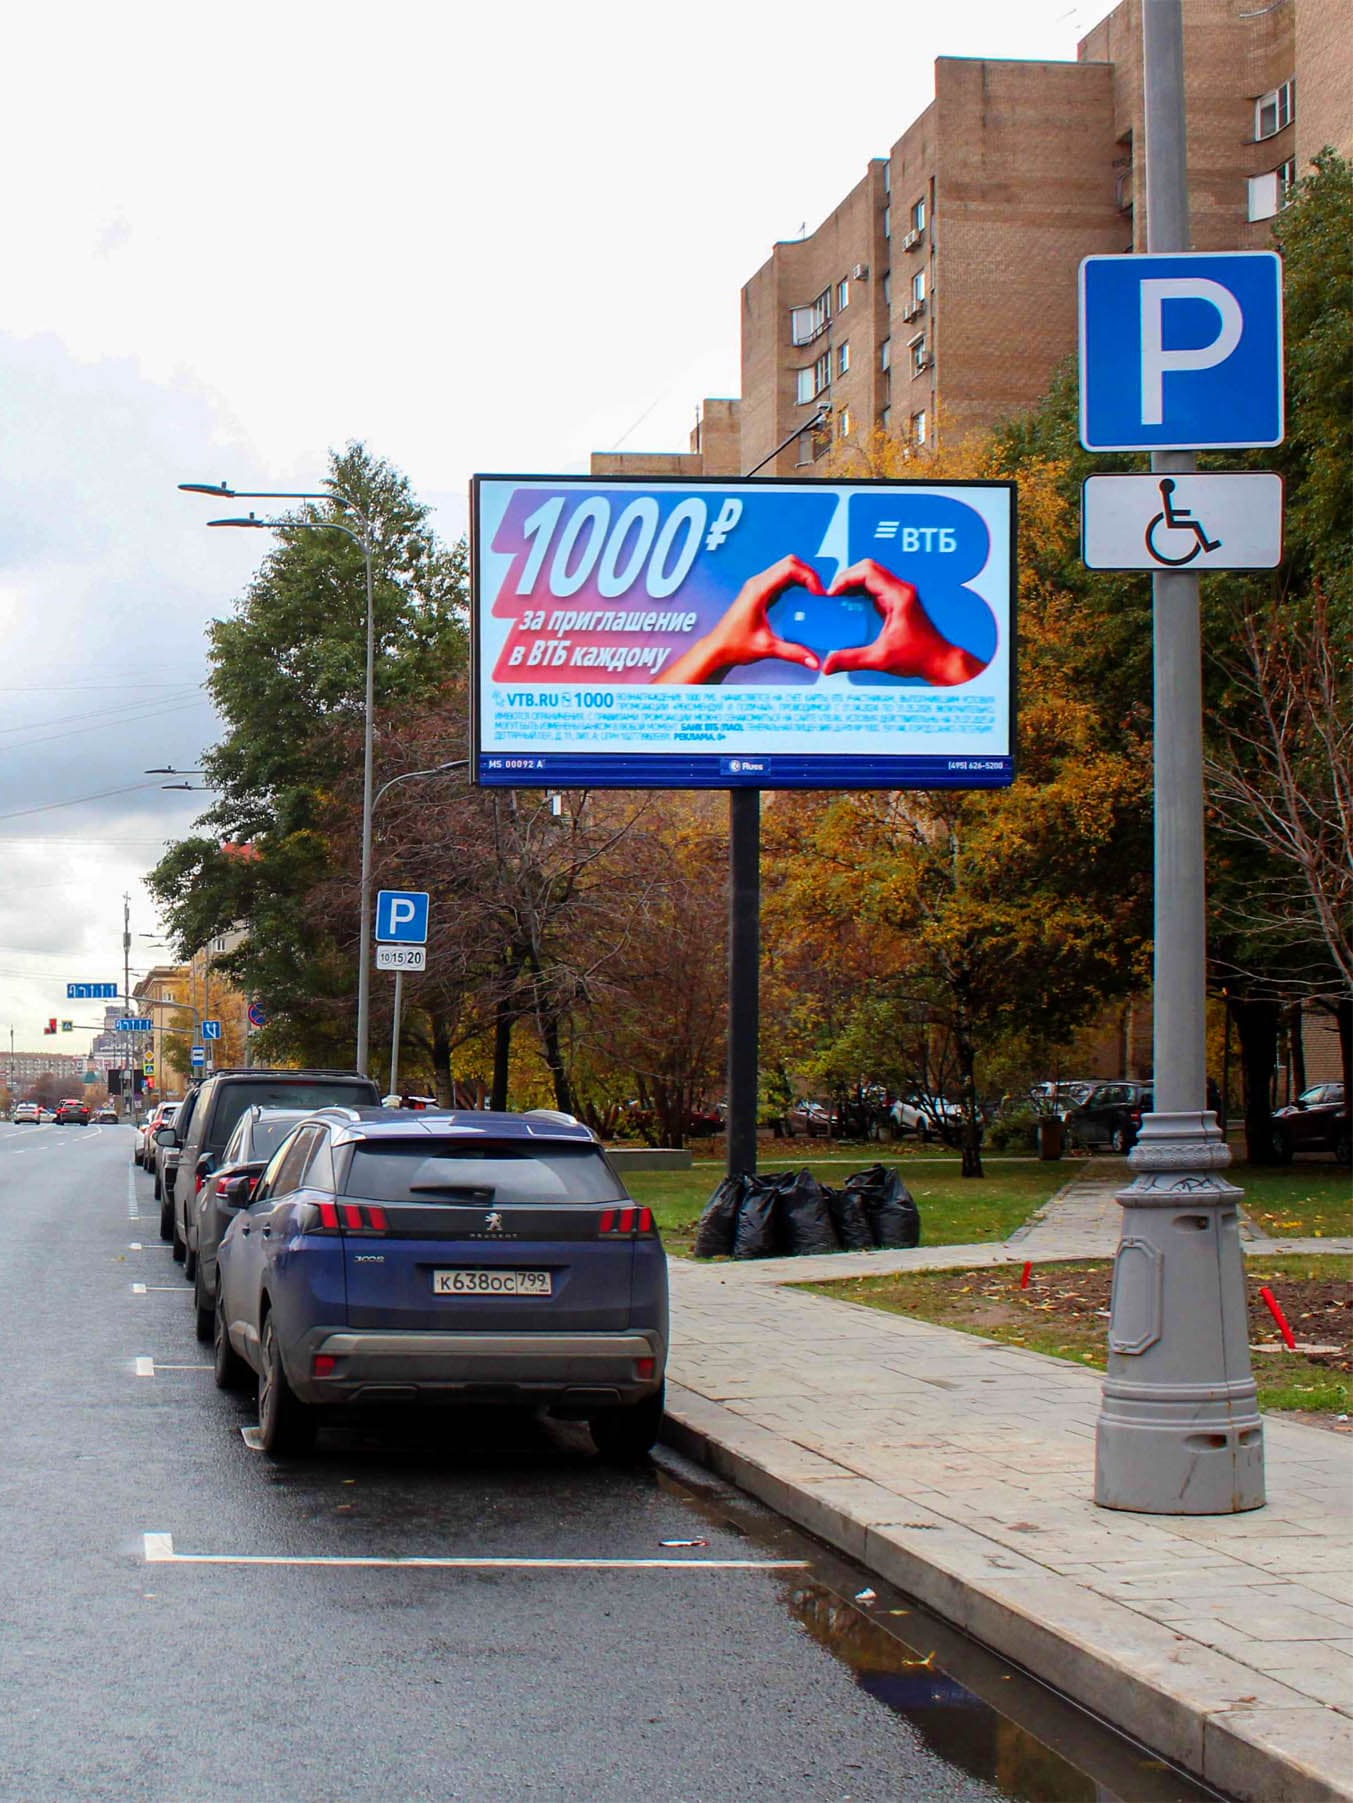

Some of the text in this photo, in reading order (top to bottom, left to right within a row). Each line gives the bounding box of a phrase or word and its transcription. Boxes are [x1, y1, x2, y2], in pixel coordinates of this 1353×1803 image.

[1140, 277, 1243, 425] P
[902, 527, 957, 553] ВТБ
[518, 610, 697, 638] за приглашение
[508, 640, 672, 674] в ВТБ каждому
[507, 693, 559, 707] VTB.RU
[574, 692, 614, 708] 1000
[505, 760, 534, 768] 00092
[389, 898, 416, 935] P
[381, 952, 422, 964] 10 15 20
